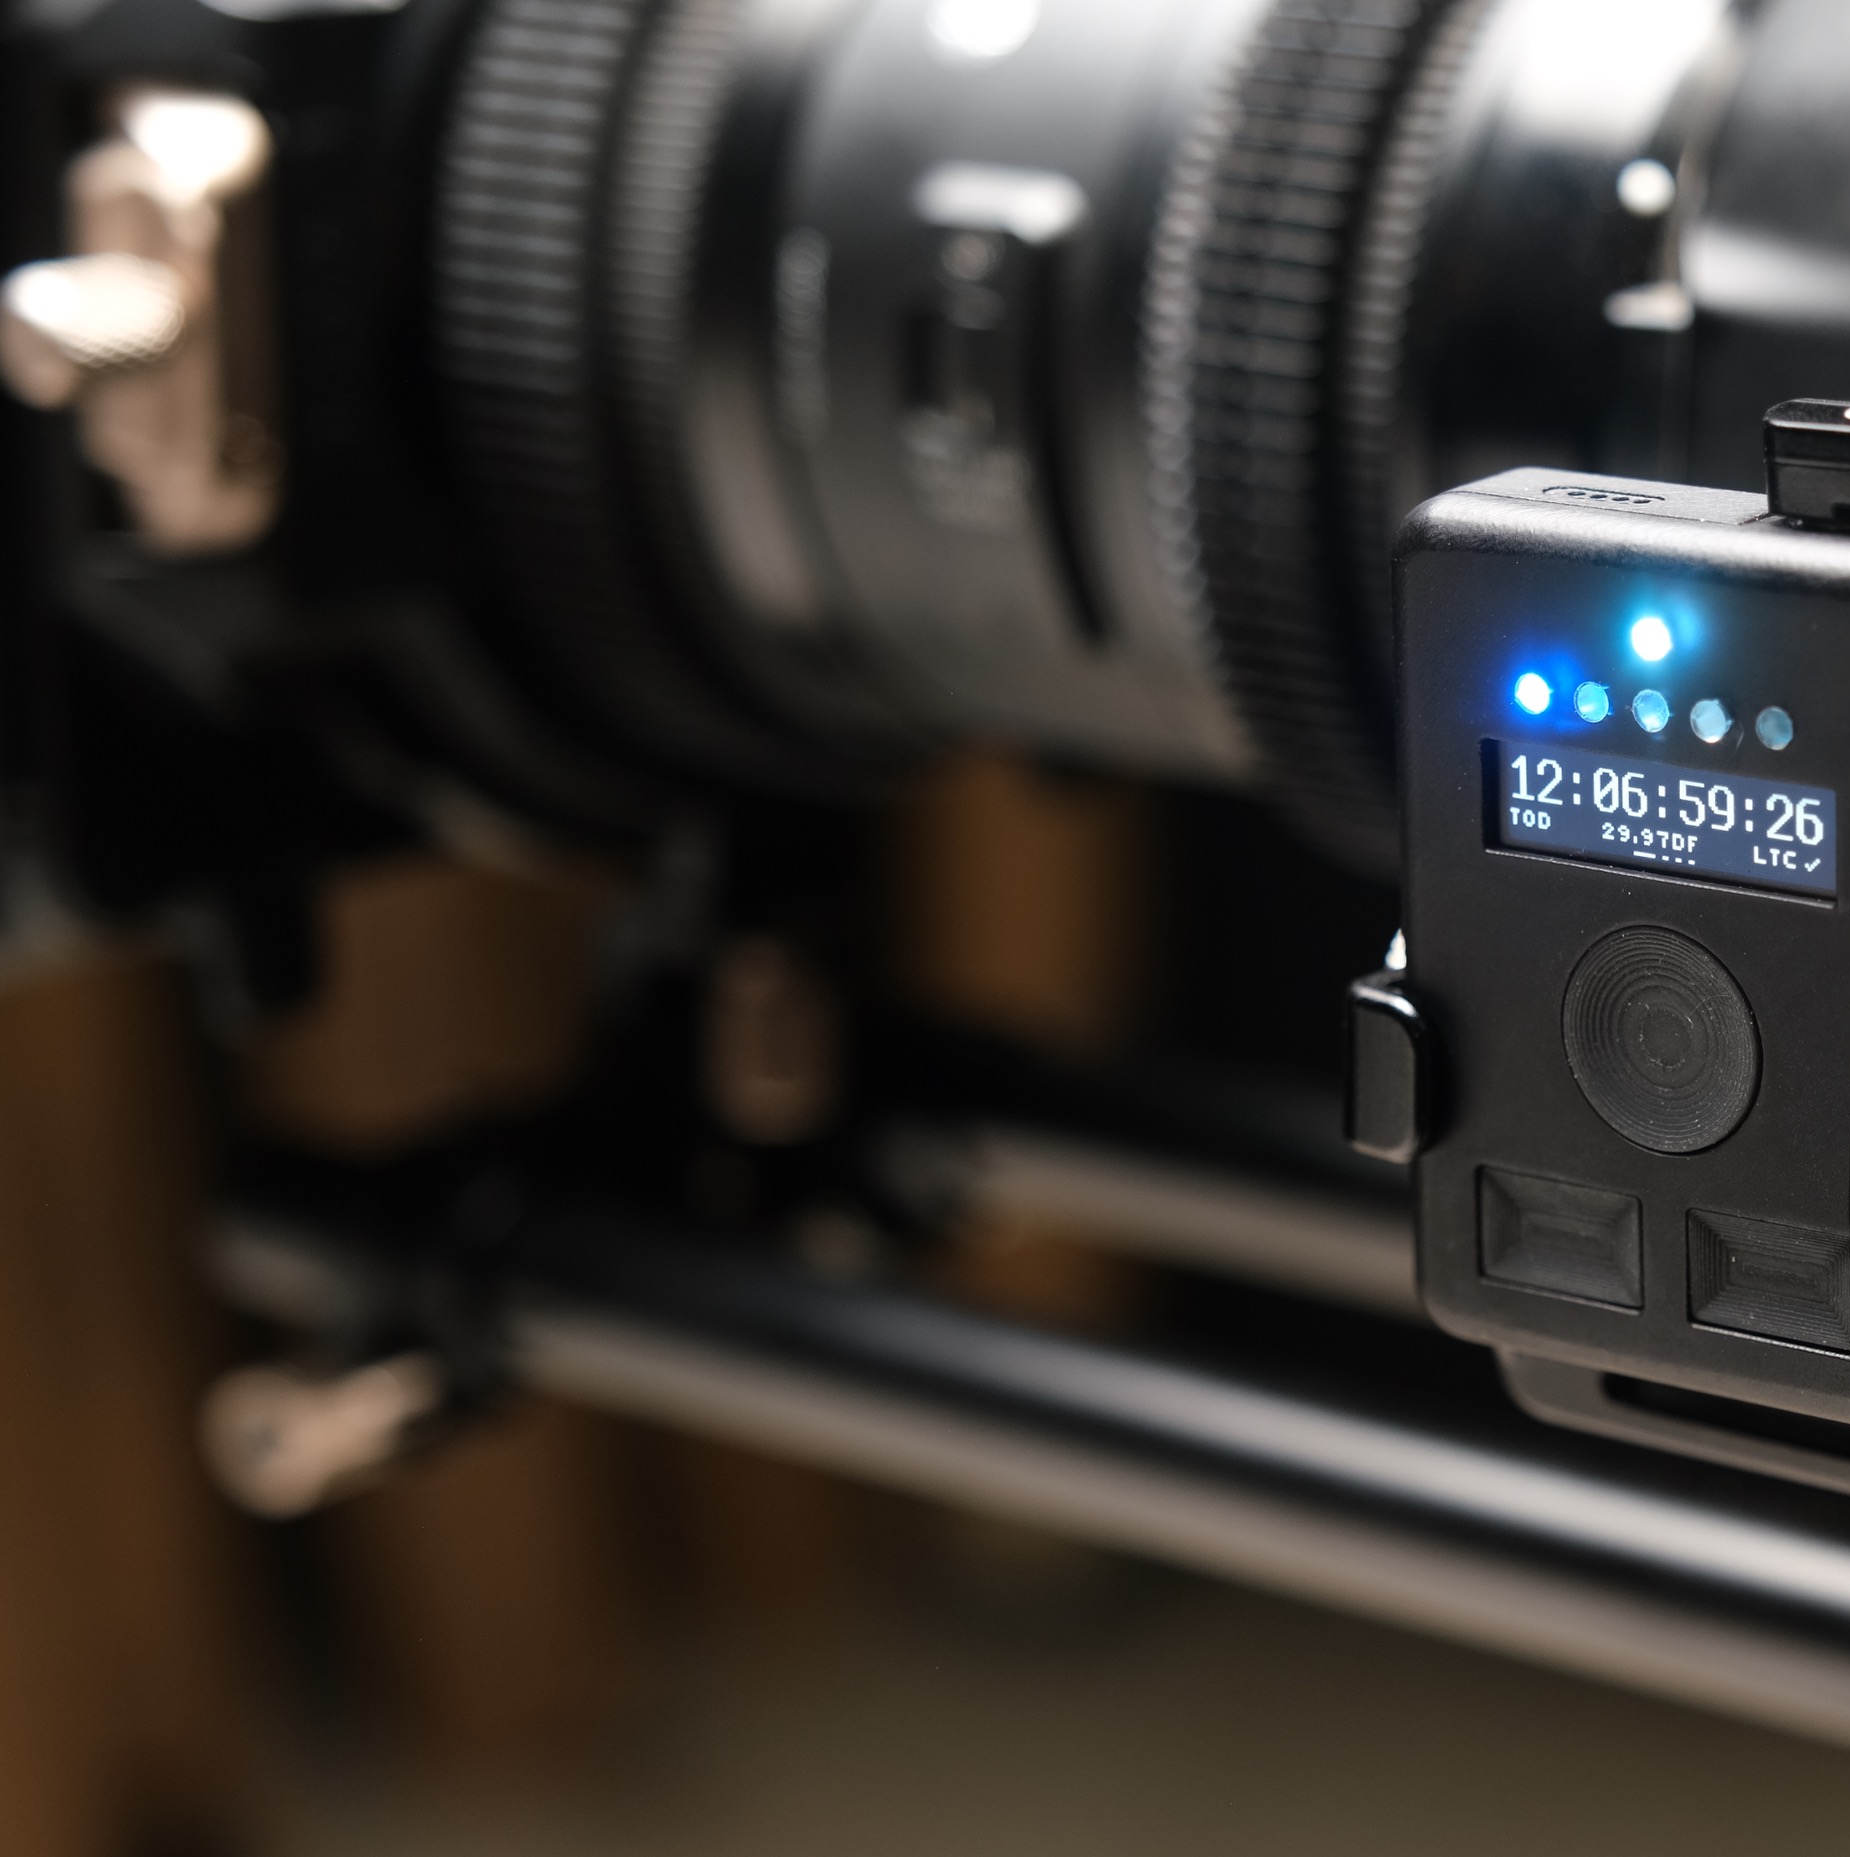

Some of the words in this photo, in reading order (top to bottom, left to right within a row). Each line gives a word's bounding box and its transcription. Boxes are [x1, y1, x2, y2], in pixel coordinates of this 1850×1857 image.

[1510, 754, 1824, 846] 12:06:59:26
[1509, 807, 1552, 831] TOD
[1601, 822, 1698, 853] 29.97DF
[1753, 846, 1798, 870] LTC
